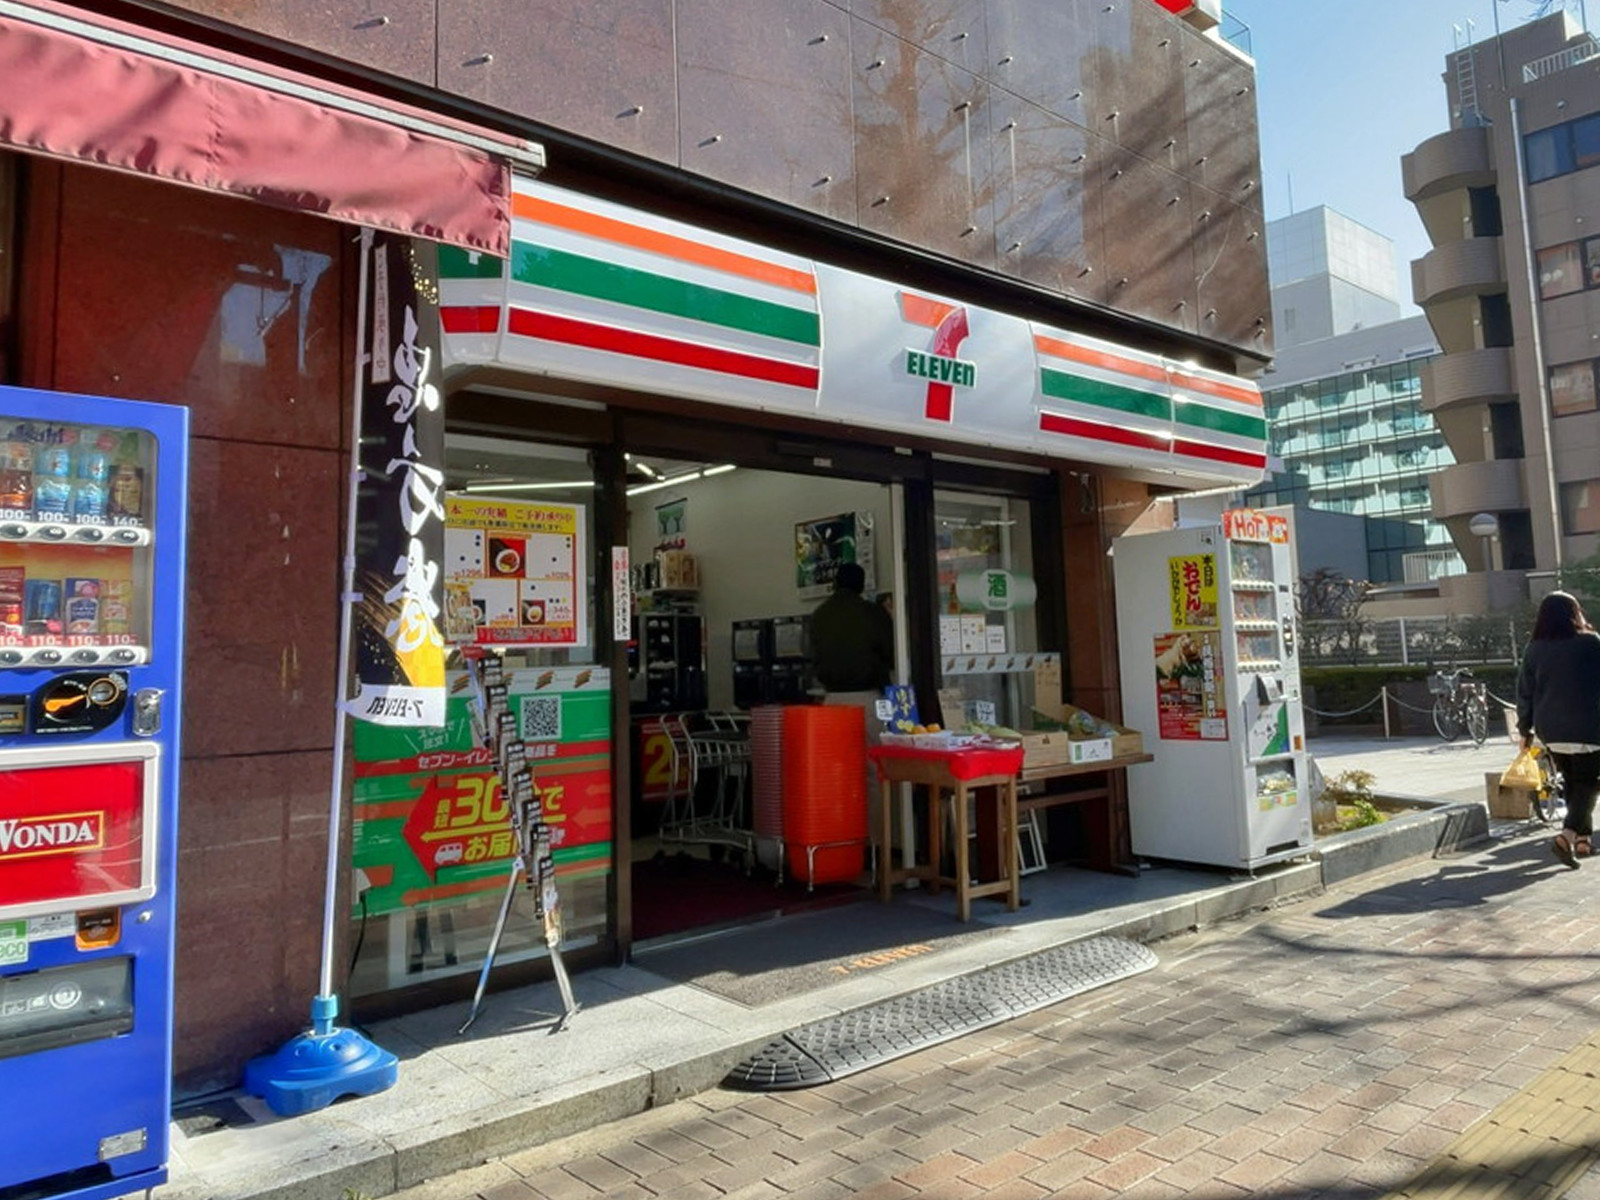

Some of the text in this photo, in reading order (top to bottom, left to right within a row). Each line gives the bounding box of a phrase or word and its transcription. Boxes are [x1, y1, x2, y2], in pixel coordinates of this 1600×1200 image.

[987, 573, 1008, 598] 酒
[1183, 560, 1202, 611] おでん
